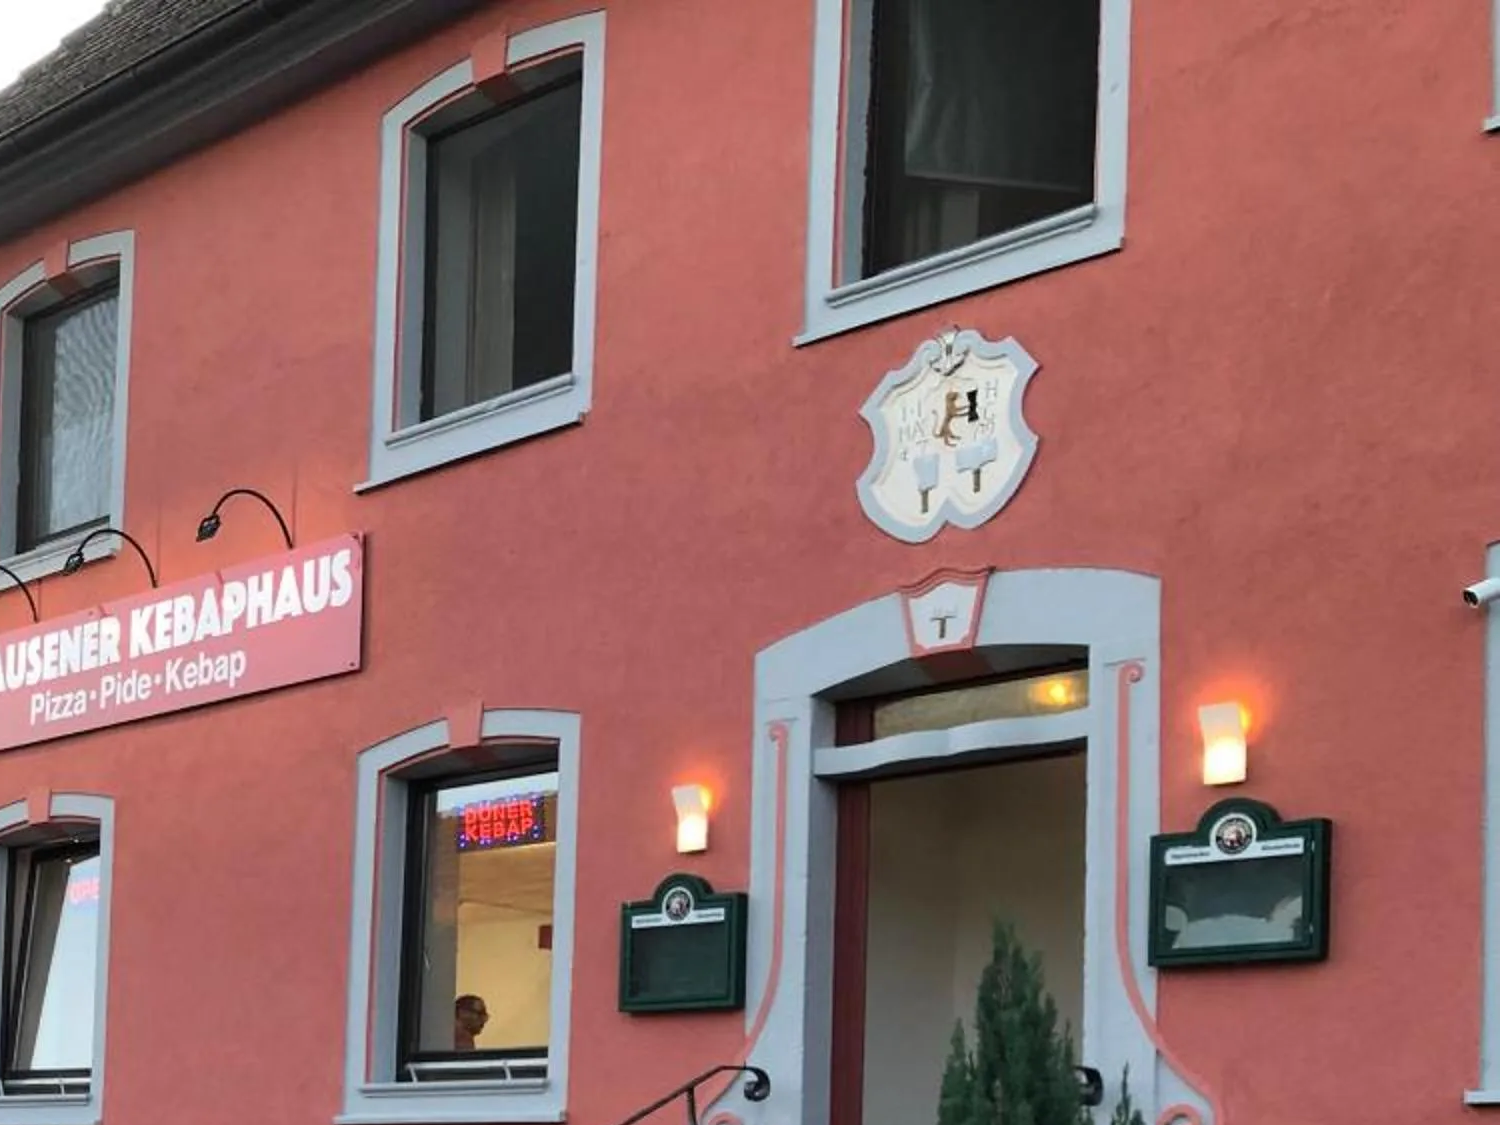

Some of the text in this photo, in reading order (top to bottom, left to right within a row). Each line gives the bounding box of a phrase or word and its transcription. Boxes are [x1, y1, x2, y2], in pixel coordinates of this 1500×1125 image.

[129, 548, 353, 660] KEBAPHAUS
[29, 649, 247, 726] Pizza Pide Kebap
[464, 817, 534, 842] KEBAP
